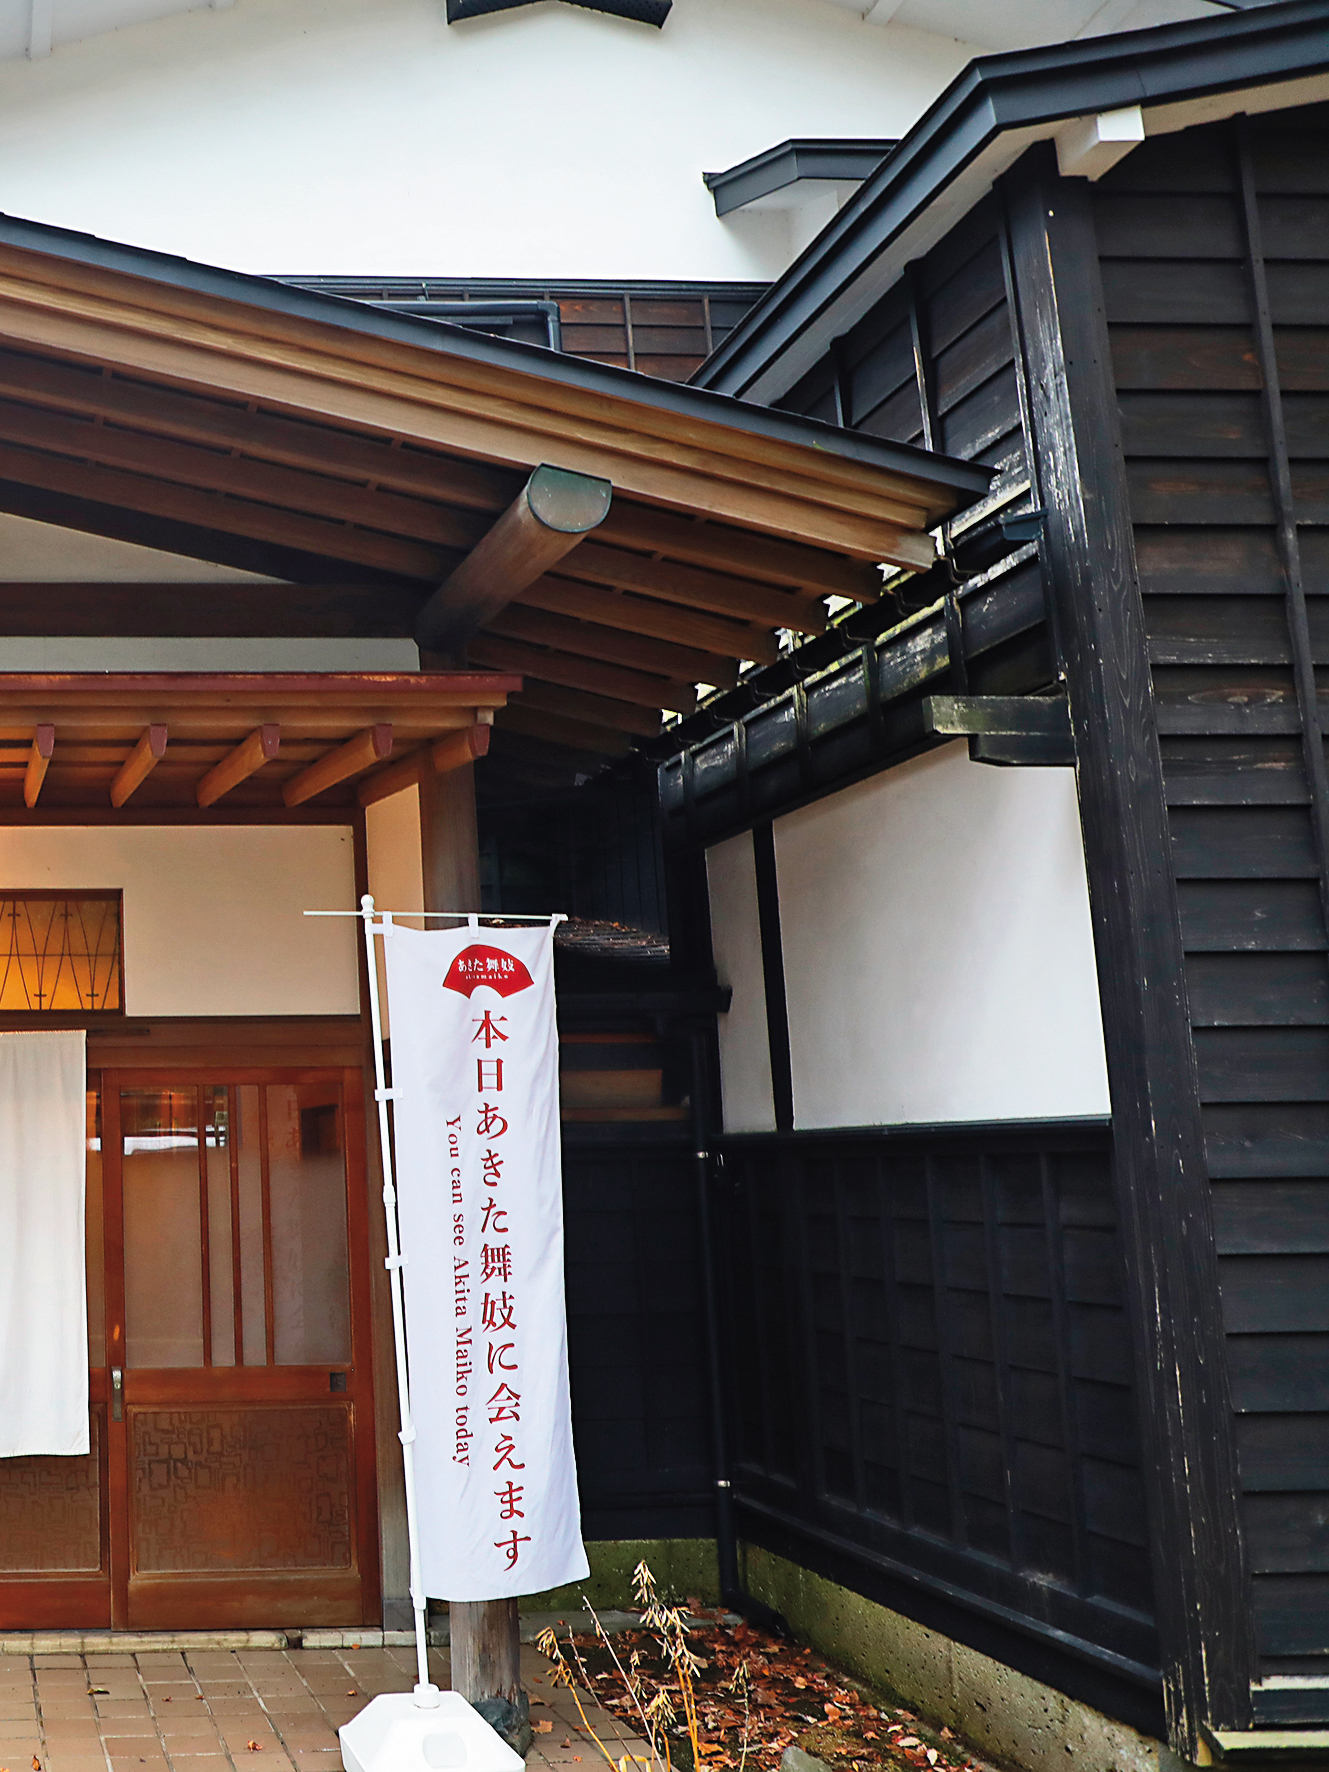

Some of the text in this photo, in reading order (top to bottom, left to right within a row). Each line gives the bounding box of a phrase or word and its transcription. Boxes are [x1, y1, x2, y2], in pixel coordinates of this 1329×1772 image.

[446, 1114, 474, 1467] You can see Akita Maiko today
[470, 1009, 532, 1572] 本日あきた舞妓に会えます
